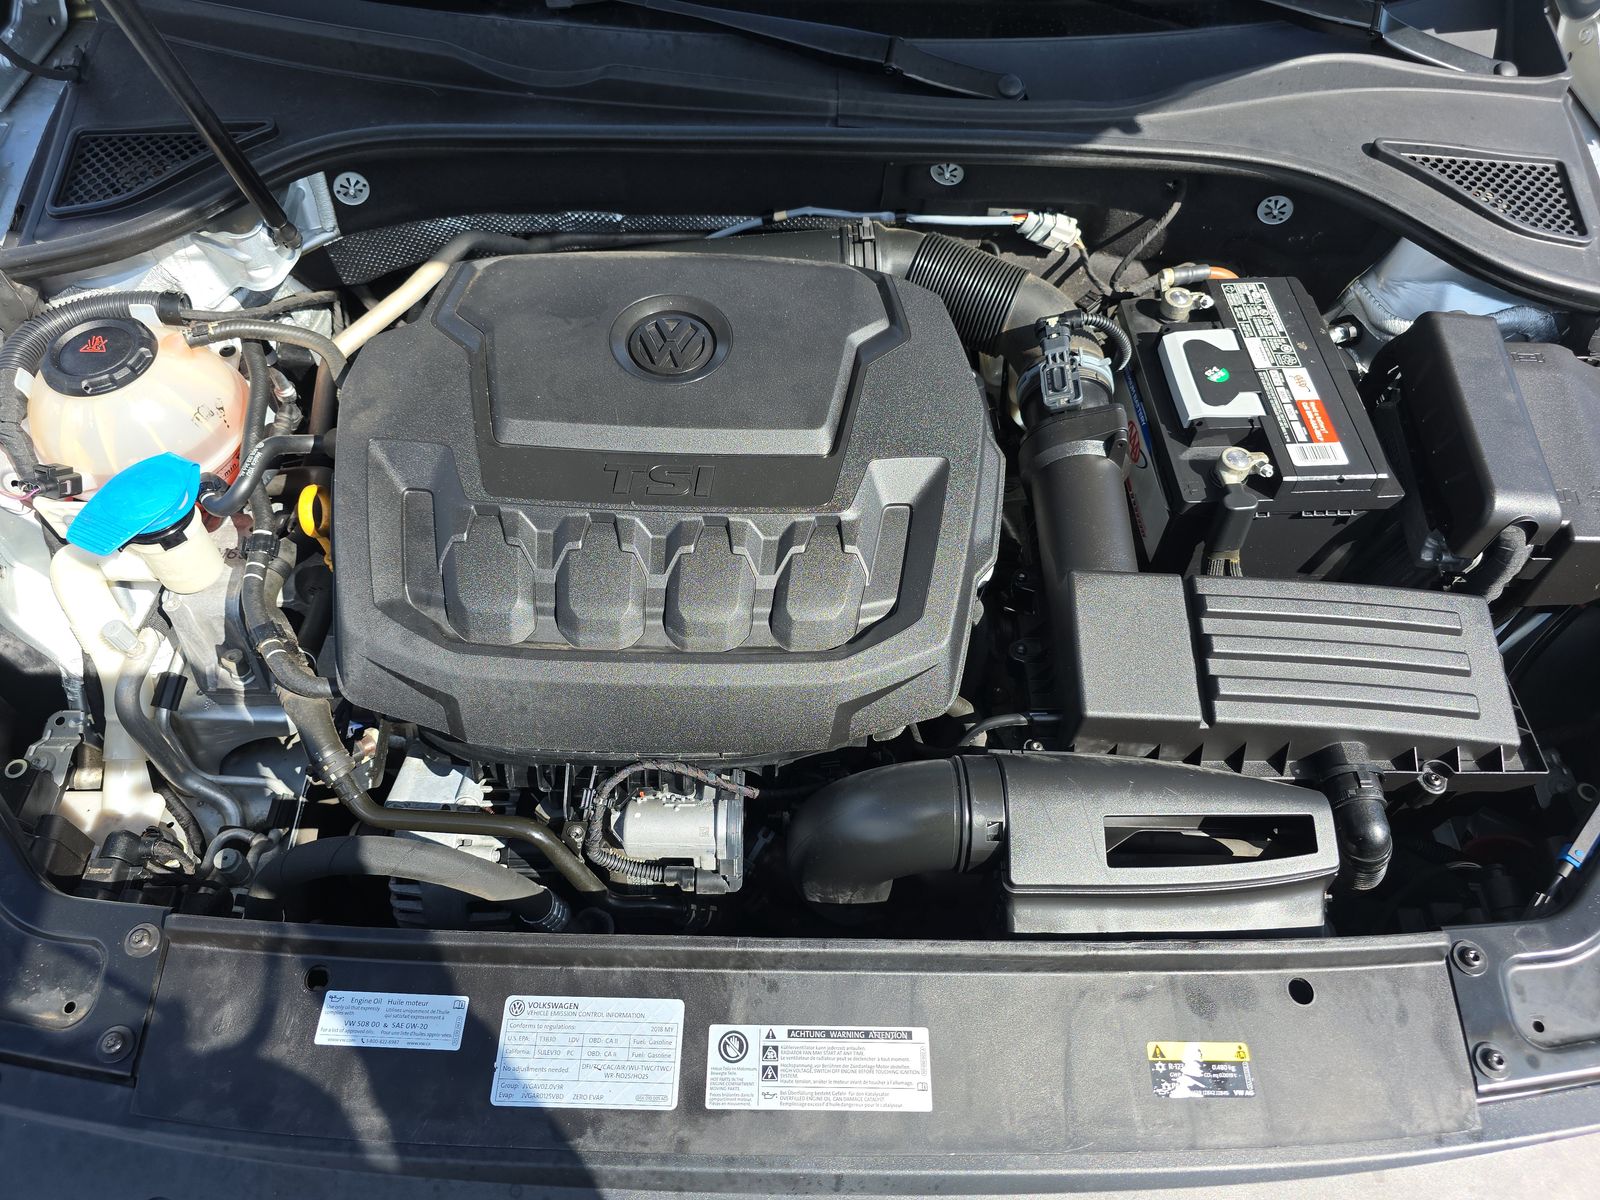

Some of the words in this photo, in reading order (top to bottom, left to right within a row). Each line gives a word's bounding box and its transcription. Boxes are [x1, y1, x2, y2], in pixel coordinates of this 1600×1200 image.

[224, 463, 237, 477] min
[604, 462, 716, 498] TSI
[869, 1031, 908, 1039] ATTENTION
